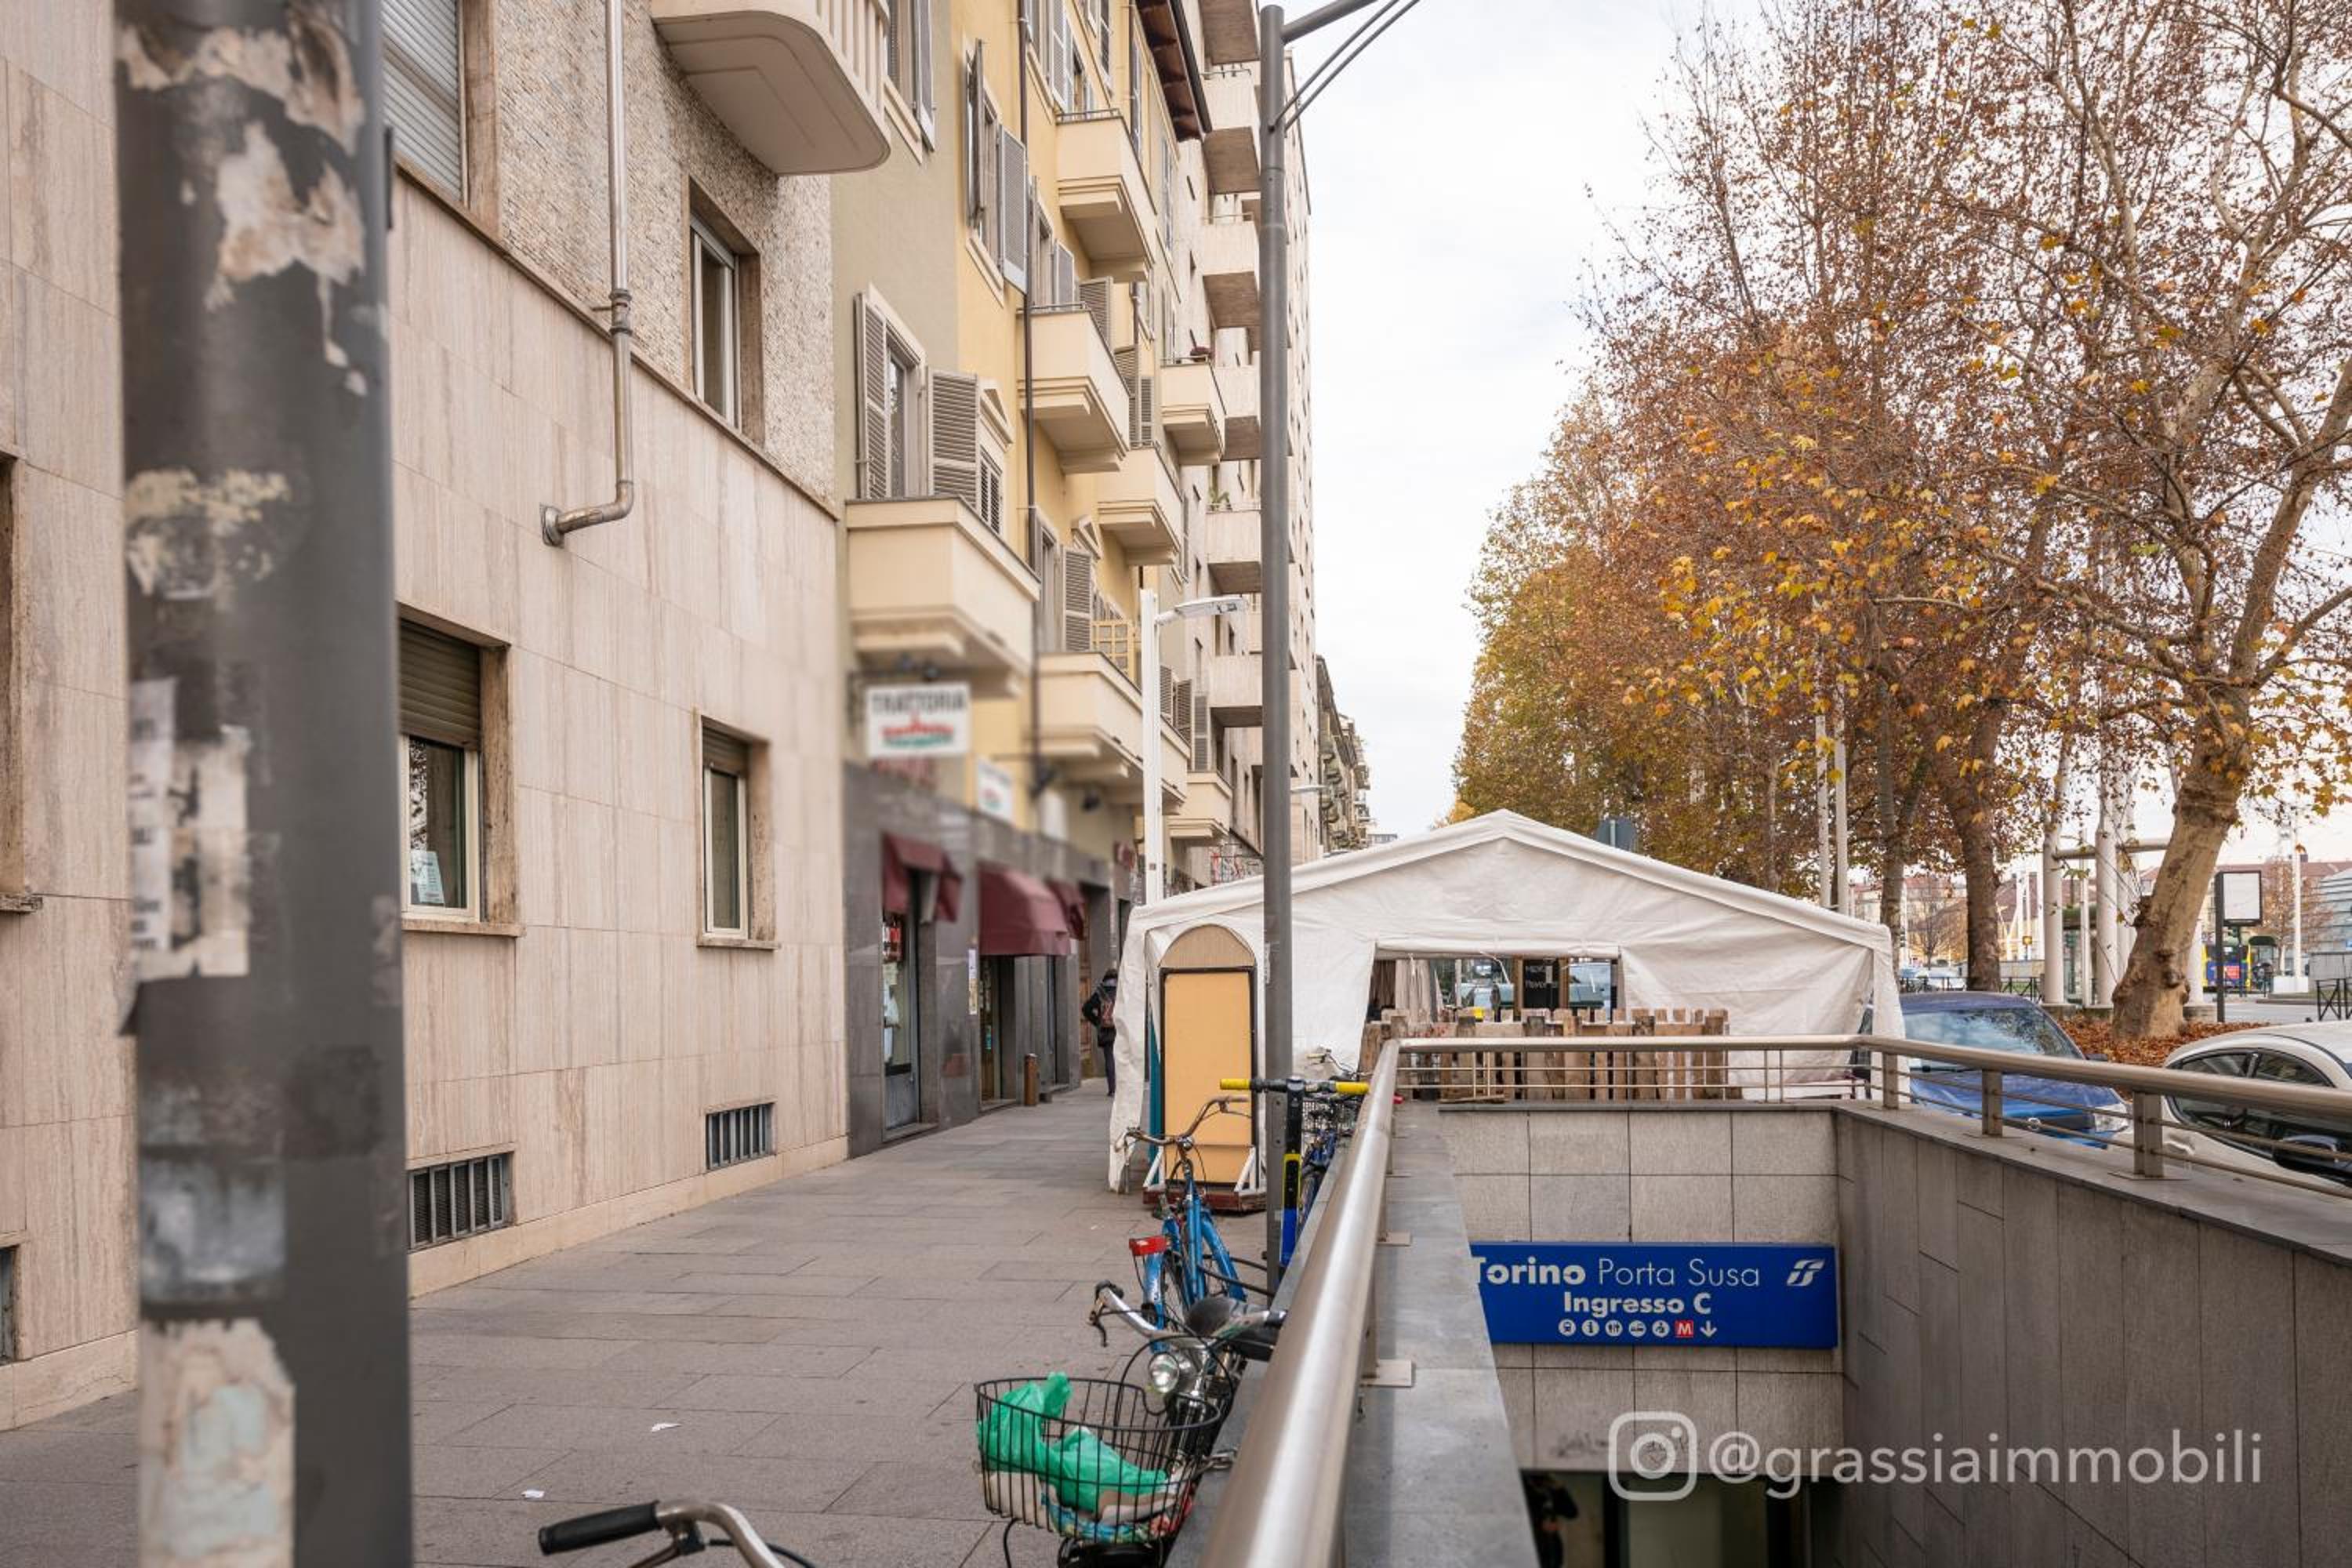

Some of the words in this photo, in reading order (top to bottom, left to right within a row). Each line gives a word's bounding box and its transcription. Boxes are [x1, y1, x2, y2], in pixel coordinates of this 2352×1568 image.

[1599, 1258, 1675, 1286] Porta
[1688, 1258, 1759, 1287] Susa
[1564, 1291, 1685, 1319] Ingresso
[1693, 1292, 1711, 1315] C
[1677, 1323, 1692, 1335] M
